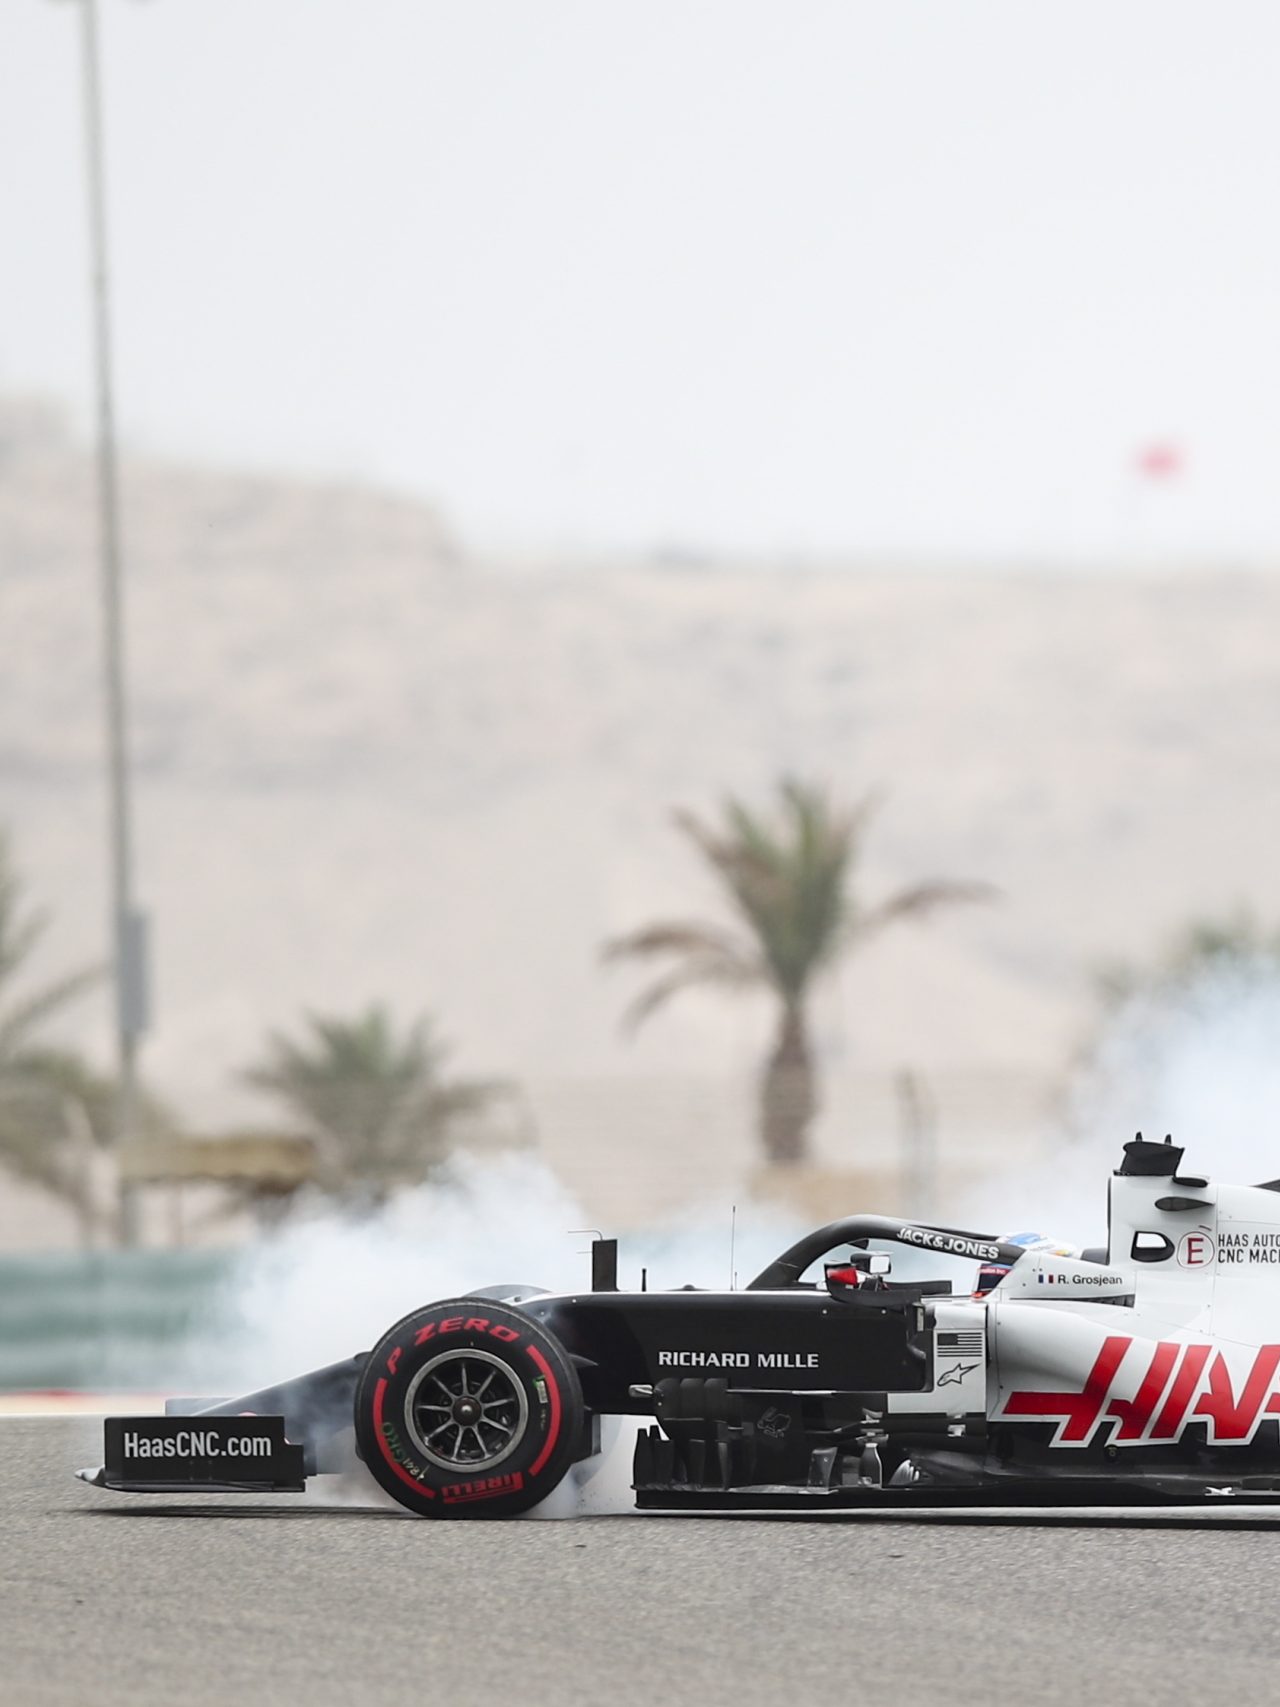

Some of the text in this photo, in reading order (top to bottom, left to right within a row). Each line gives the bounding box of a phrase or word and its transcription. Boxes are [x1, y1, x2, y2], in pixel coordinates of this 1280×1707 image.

[897, 1228, 999, 1259] JACK&JONES
[1218, 1234, 1249, 1247] HAAS
[1218, 1249, 1244, 1263] CNC
[1058, 1275, 1123, 1287] R. Grosjean
[386, 1317, 520, 1375] P ZERO
[658, 1351, 819, 1368] RICHARD MILLE
[124, 1431, 272, 1458] HaasCNC.com
[441, 1471, 525, 1504] PIRELLI
